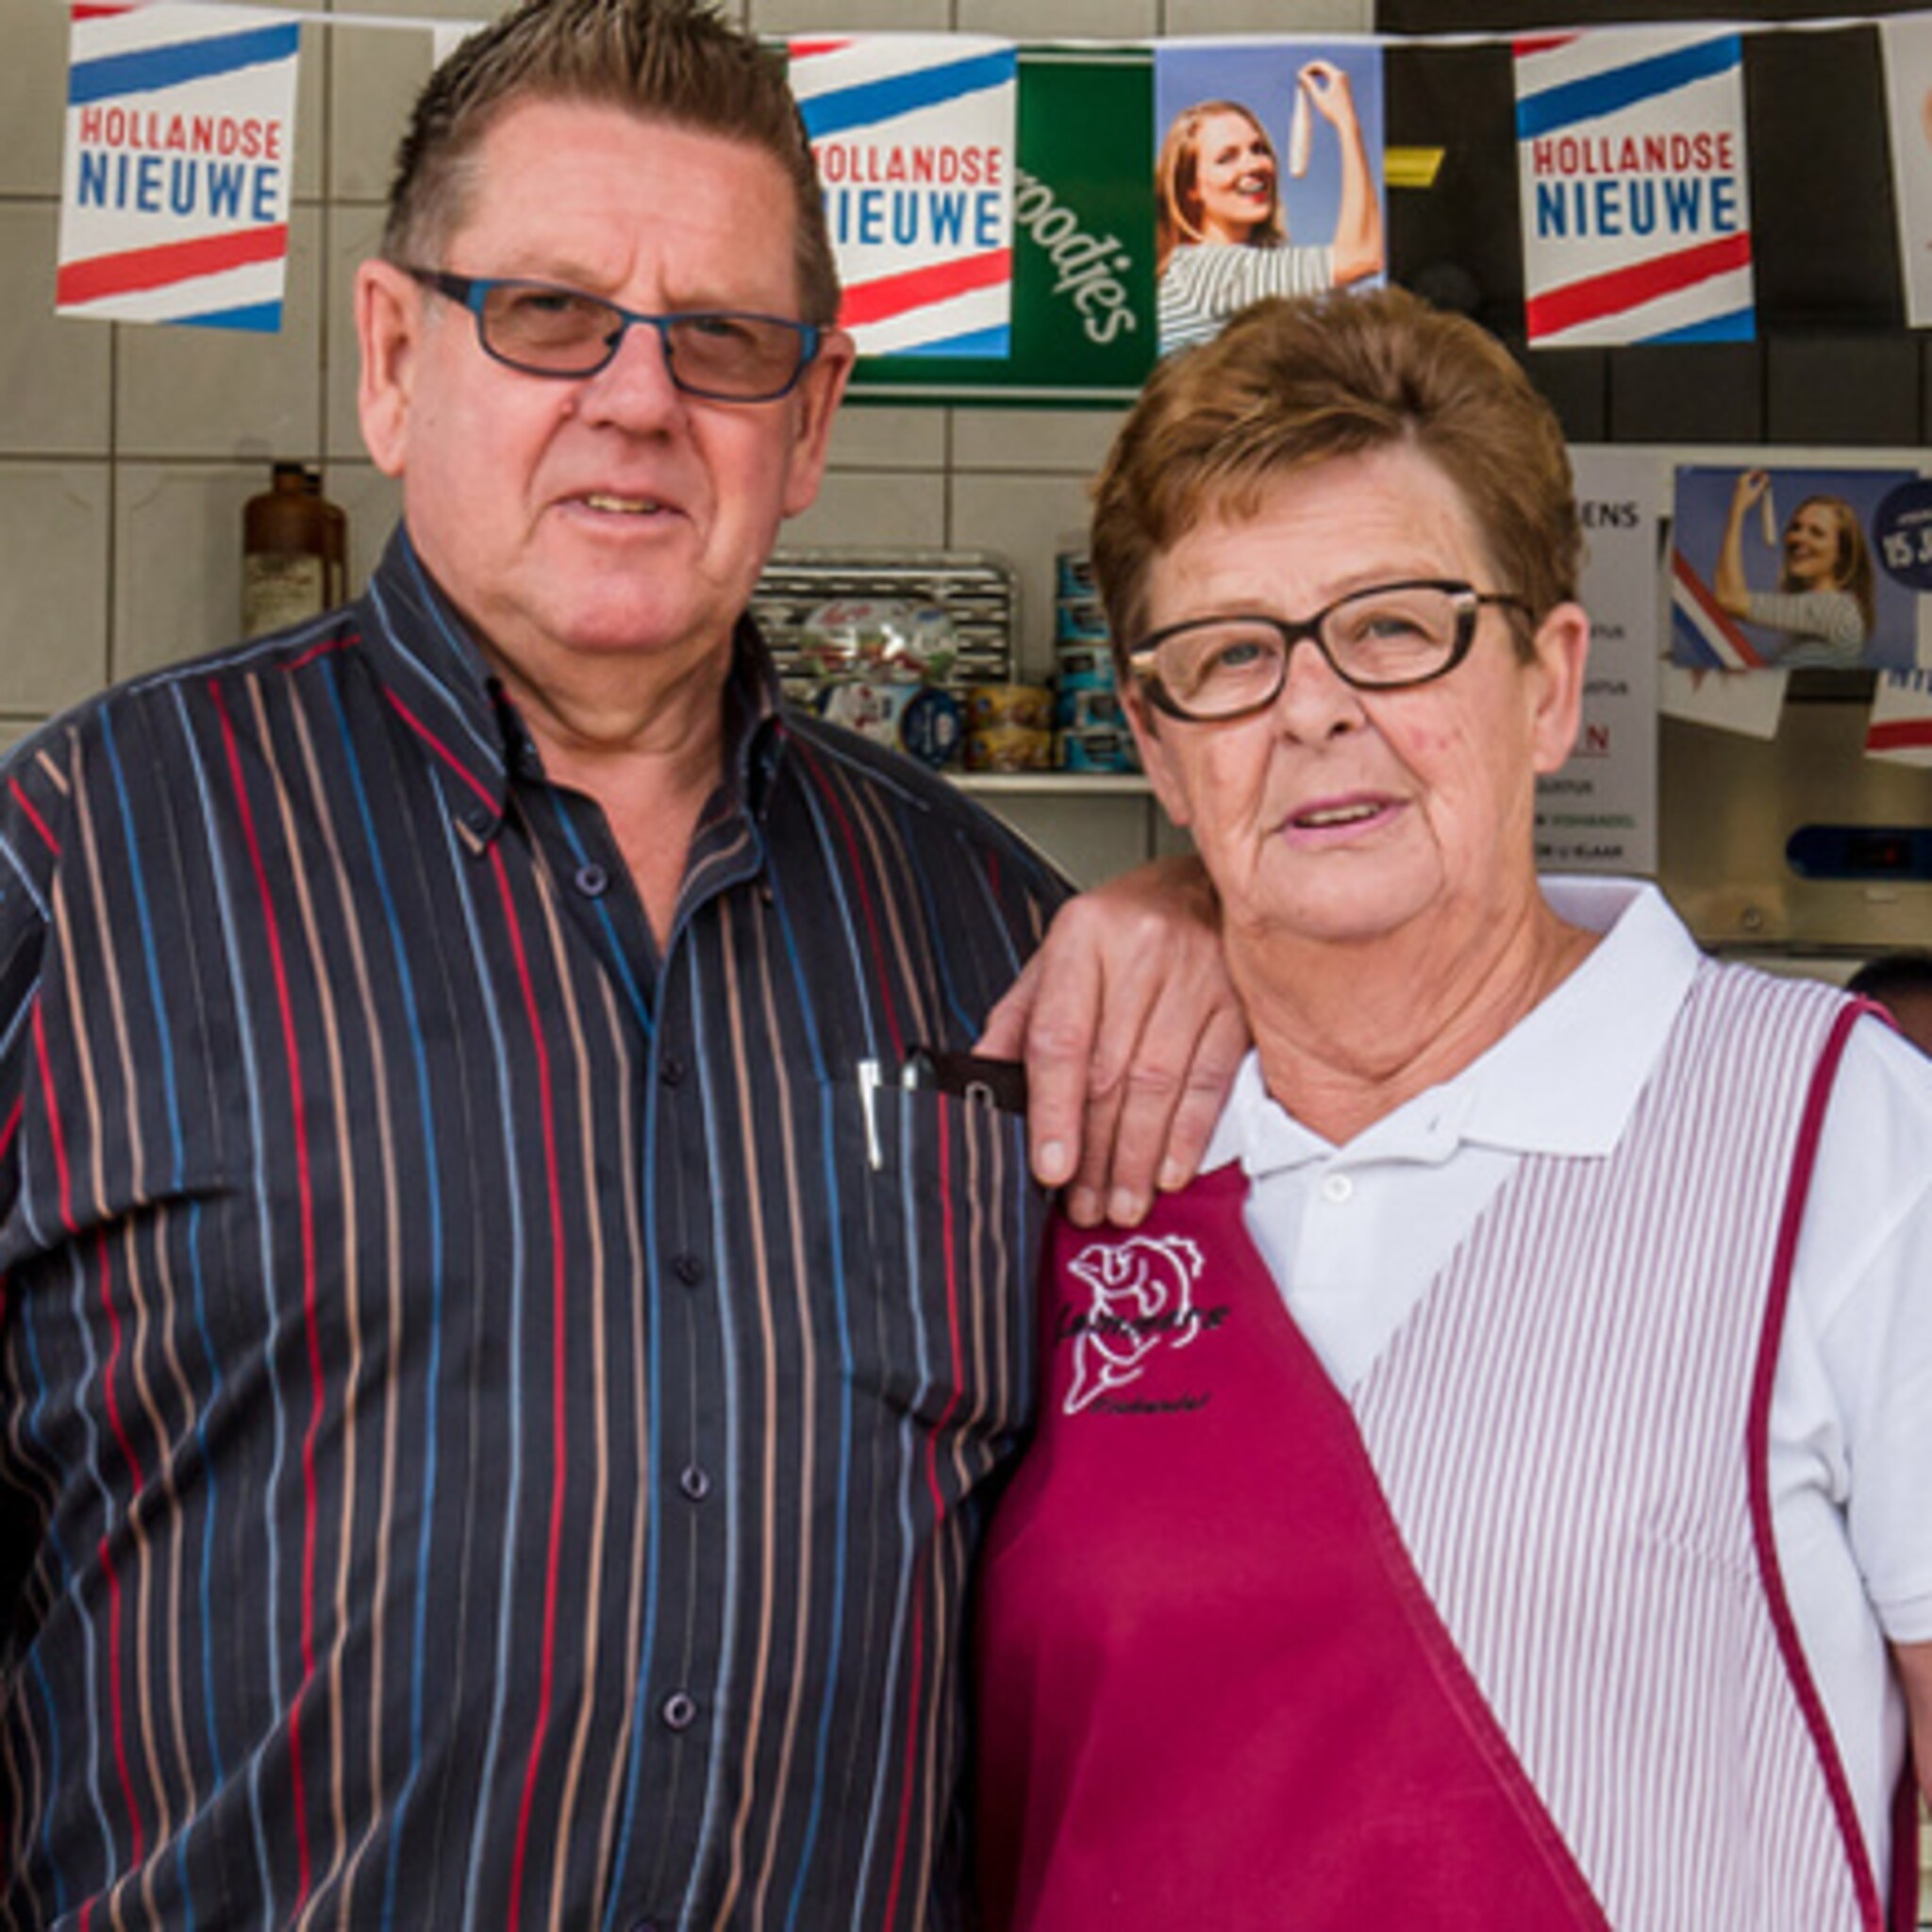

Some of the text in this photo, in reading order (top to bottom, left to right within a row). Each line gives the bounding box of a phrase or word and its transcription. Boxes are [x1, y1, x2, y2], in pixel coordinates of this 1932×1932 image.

[79, 104, 281, 160] HOLLANDSE
[1532, 131, 1734, 175] HOLLANDSE
[76, 150, 280, 223] NIEUWE
[1536, 176, 1737, 239] NIEUWE
[821, 188, 1002, 248] IEUWE
[1581, 498, 1640, 528] ENS
